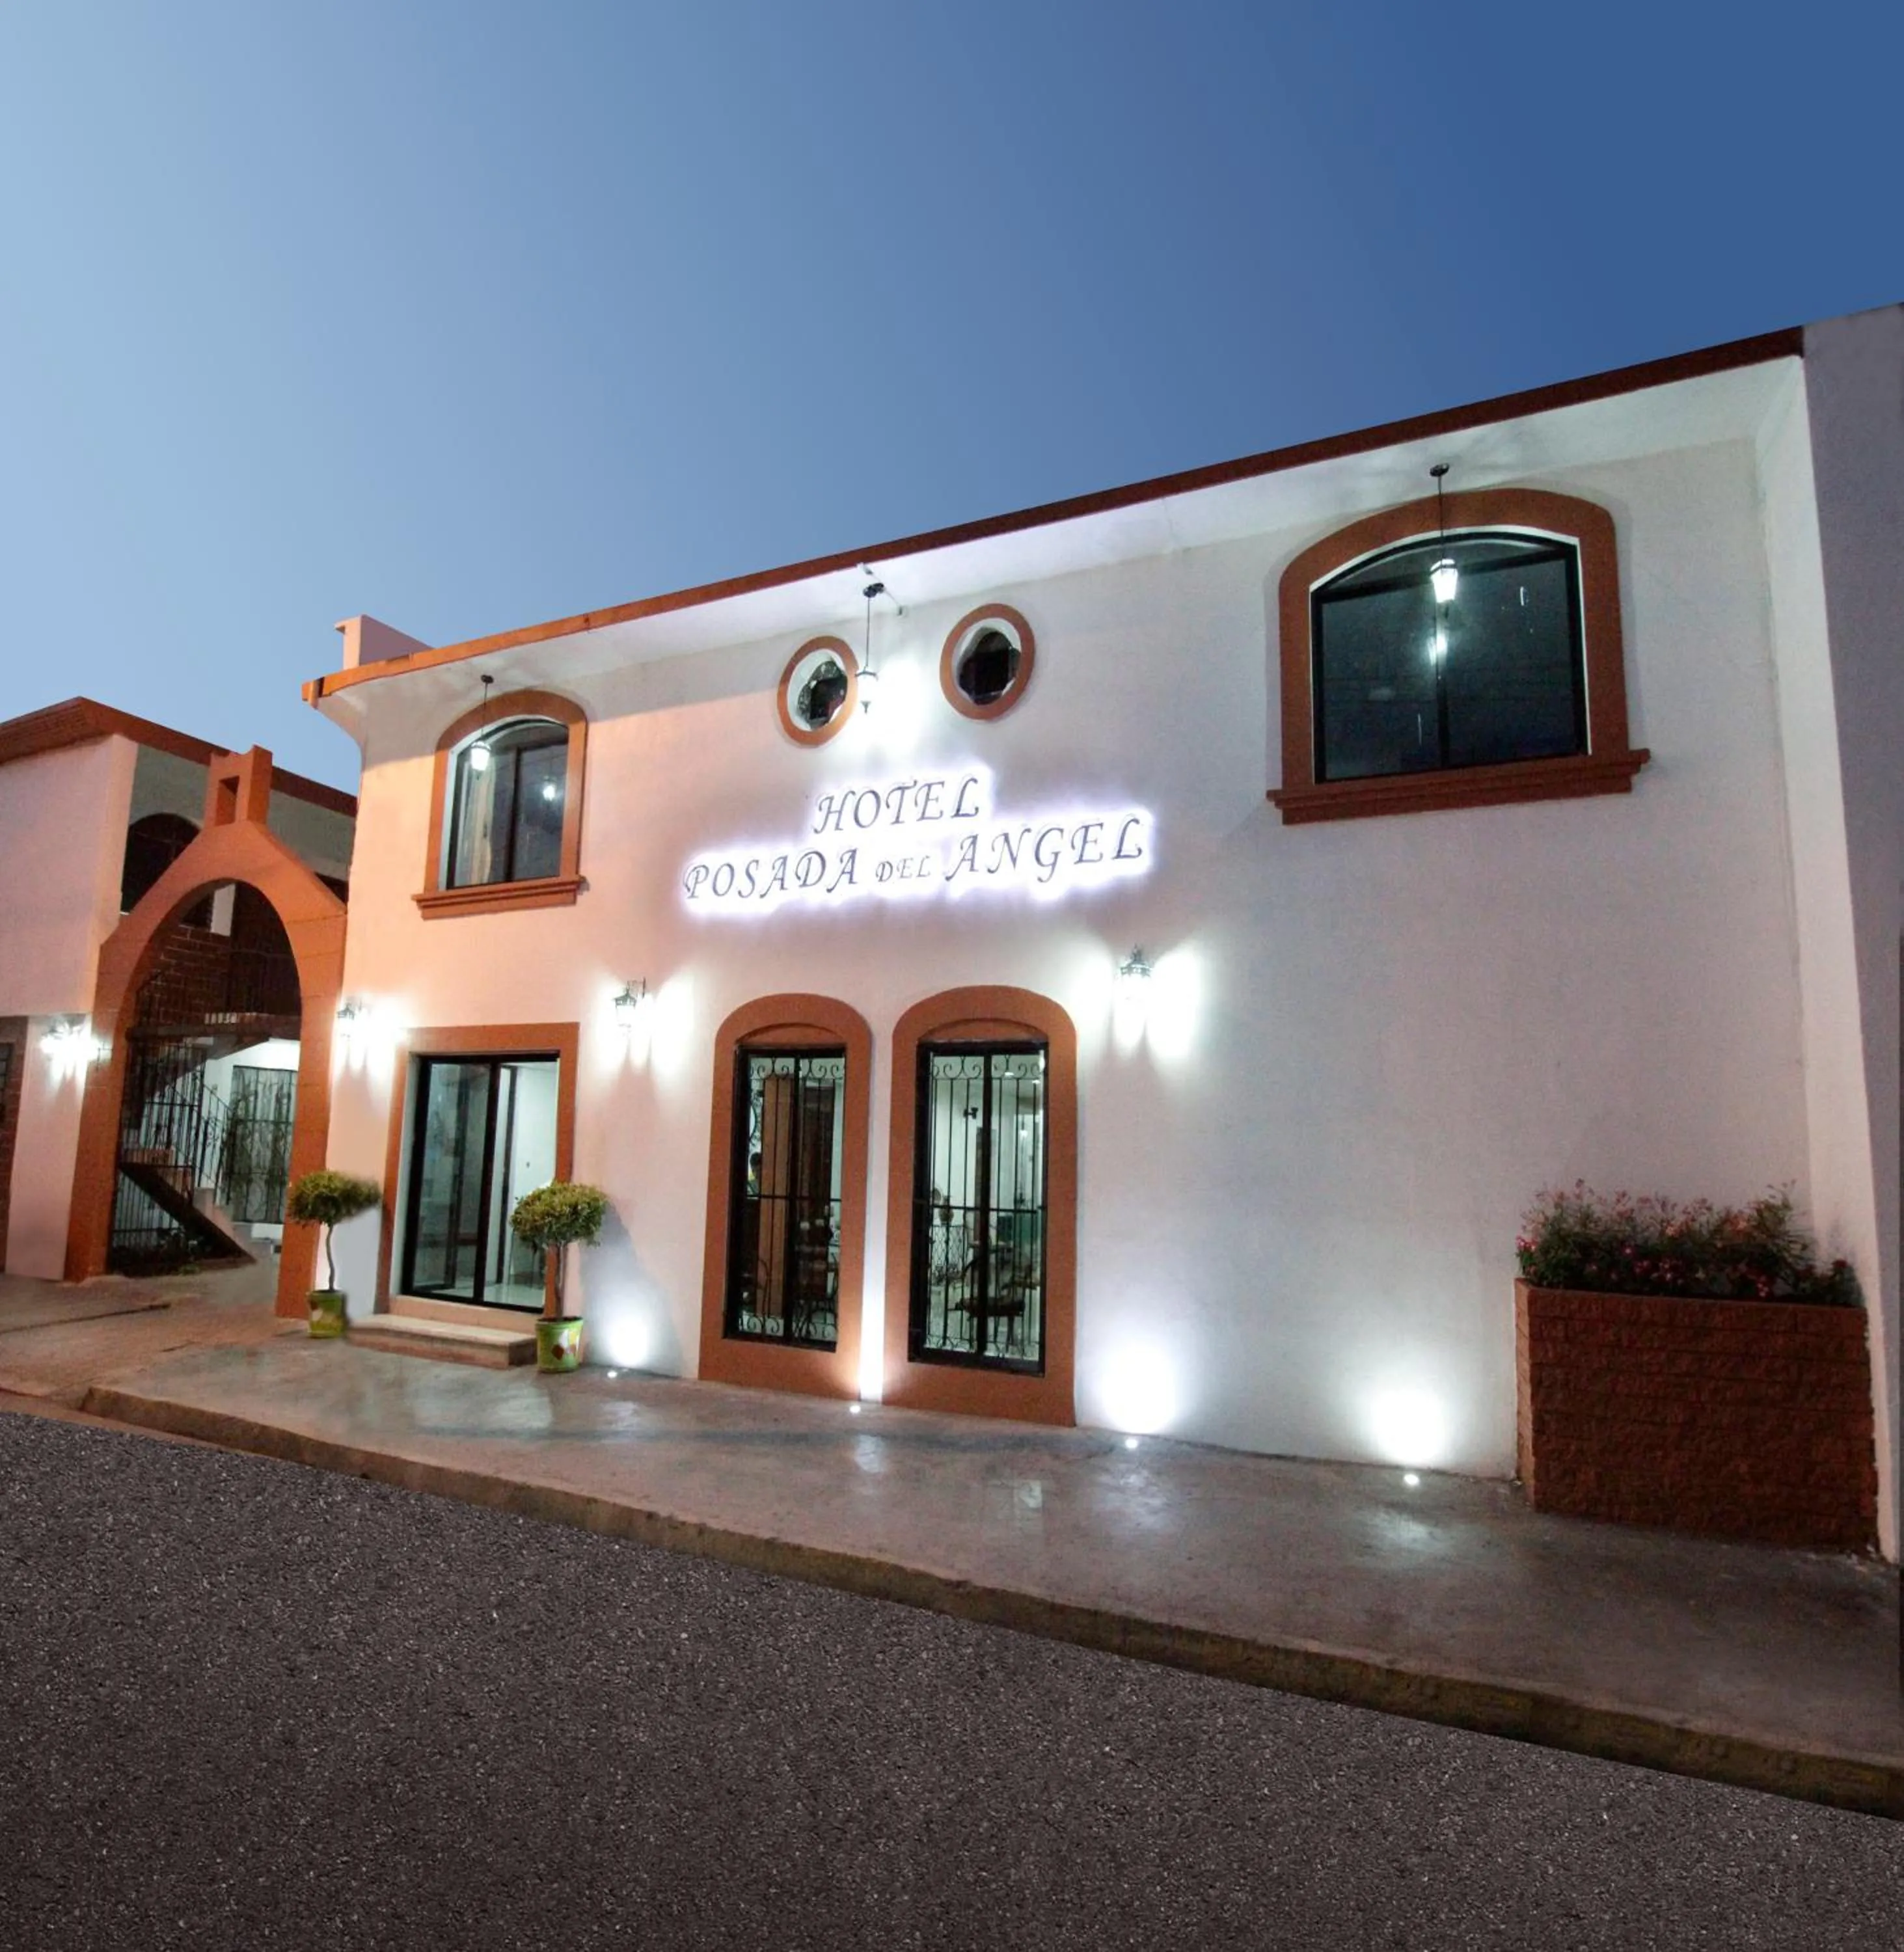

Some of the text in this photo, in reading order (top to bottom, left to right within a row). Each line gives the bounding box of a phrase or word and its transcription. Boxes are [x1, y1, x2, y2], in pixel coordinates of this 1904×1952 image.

[813, 777, 979, 834] HOTEL
[683, 818, 1144, 899] POSADA DEL ANGEL
